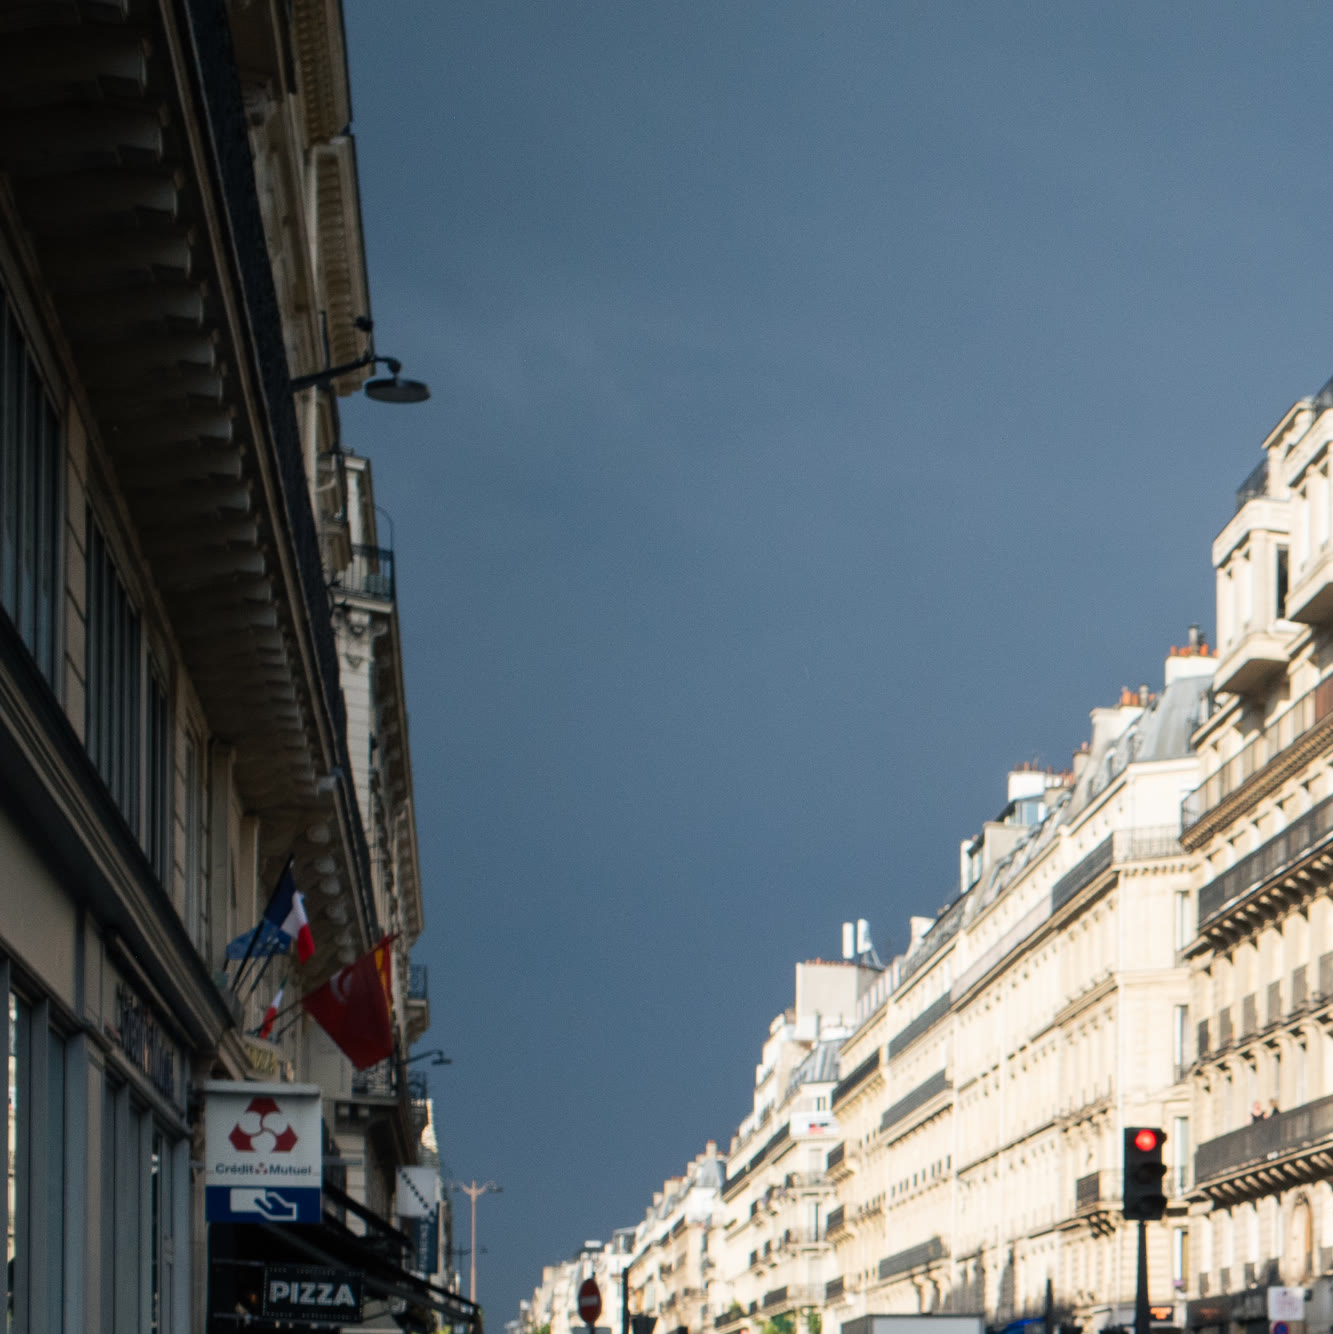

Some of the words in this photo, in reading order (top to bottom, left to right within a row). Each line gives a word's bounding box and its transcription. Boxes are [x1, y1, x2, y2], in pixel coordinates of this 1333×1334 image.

[215, 1162, 253, 1176] Crédit
[269, 1163, 312, 1176] Mutuel
[269, 1279, 357, 1307] PIZZA
